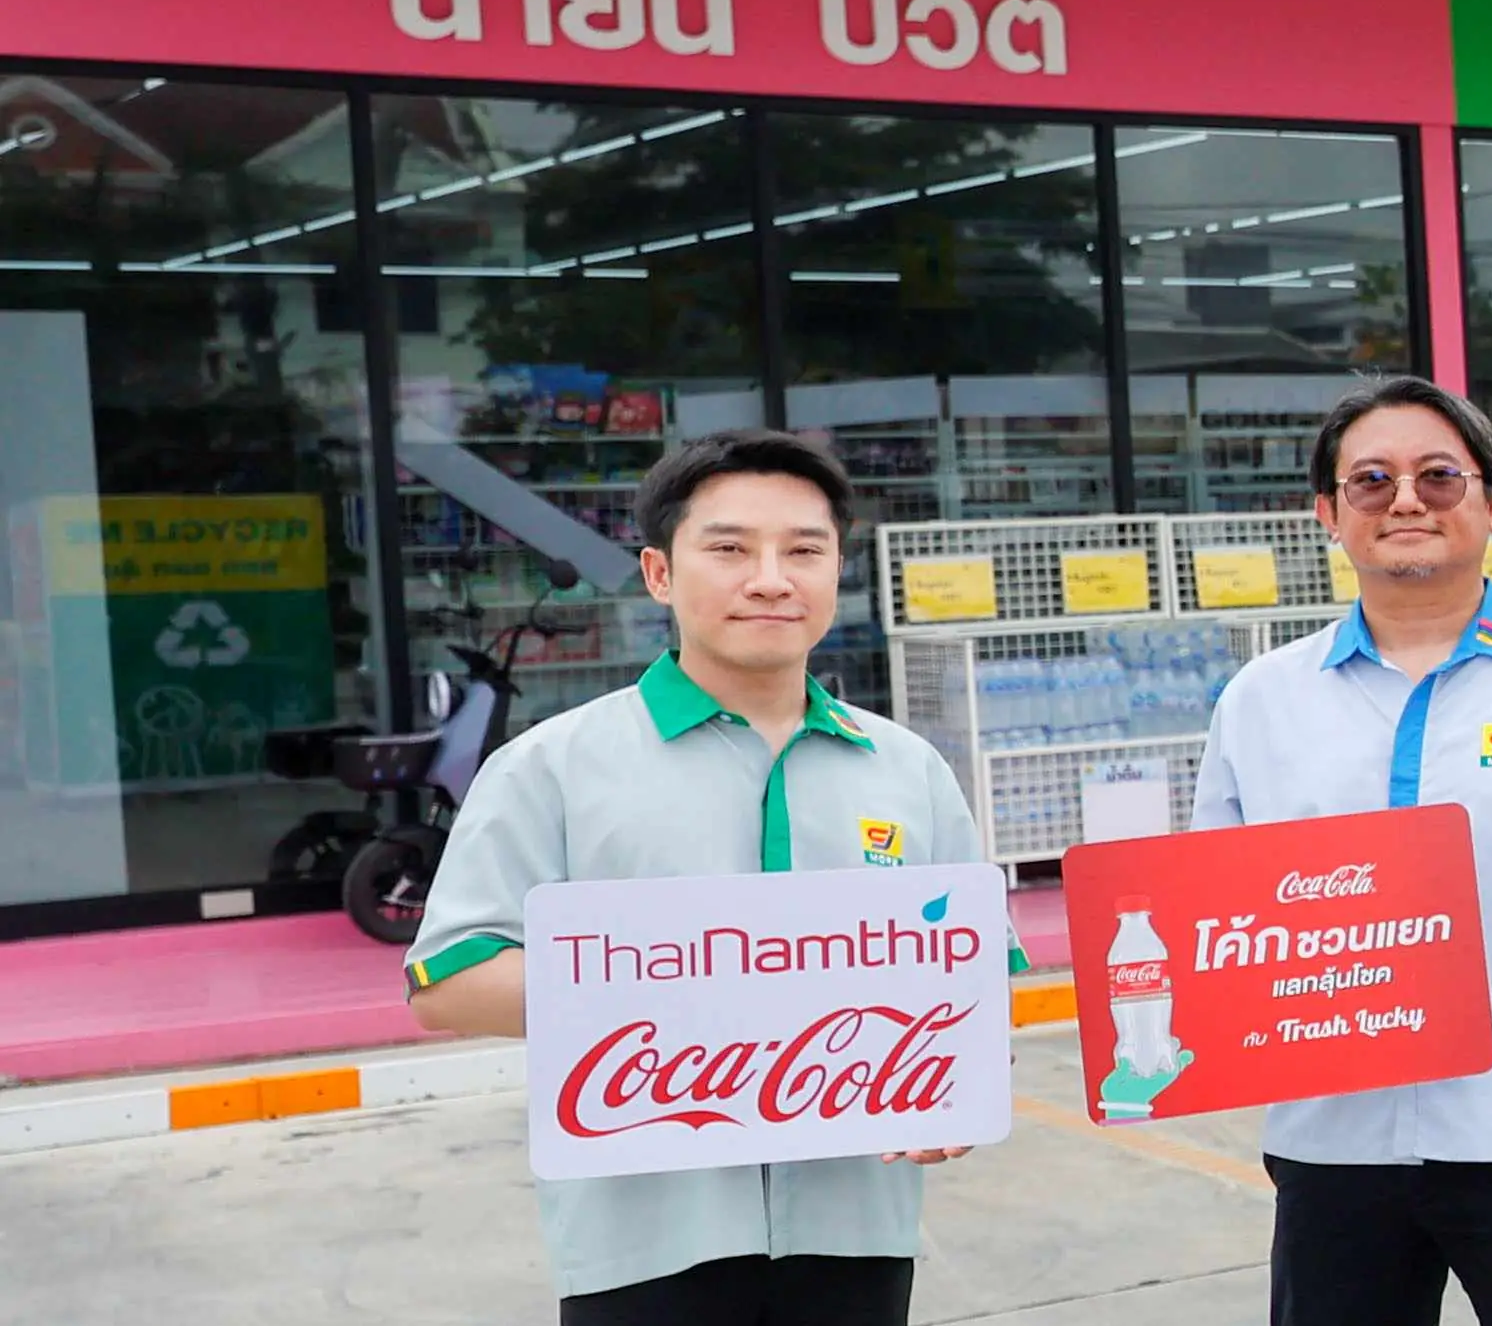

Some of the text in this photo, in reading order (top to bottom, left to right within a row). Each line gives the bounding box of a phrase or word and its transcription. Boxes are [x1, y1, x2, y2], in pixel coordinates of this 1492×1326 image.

[1275, 863, 1377, 904] Coca-Cola
[552, 891, 980, 985] ThaiNamthip
[1194, 913, 1451, 972] โค้ก ชวนแยก
[1272, 962, 1391, 1002] แลกลุ้นโชค
[1242, 1003, 1426, 1048] กับ Trash Lucky
[557, 999, 980, 1138] Coca-Cola
